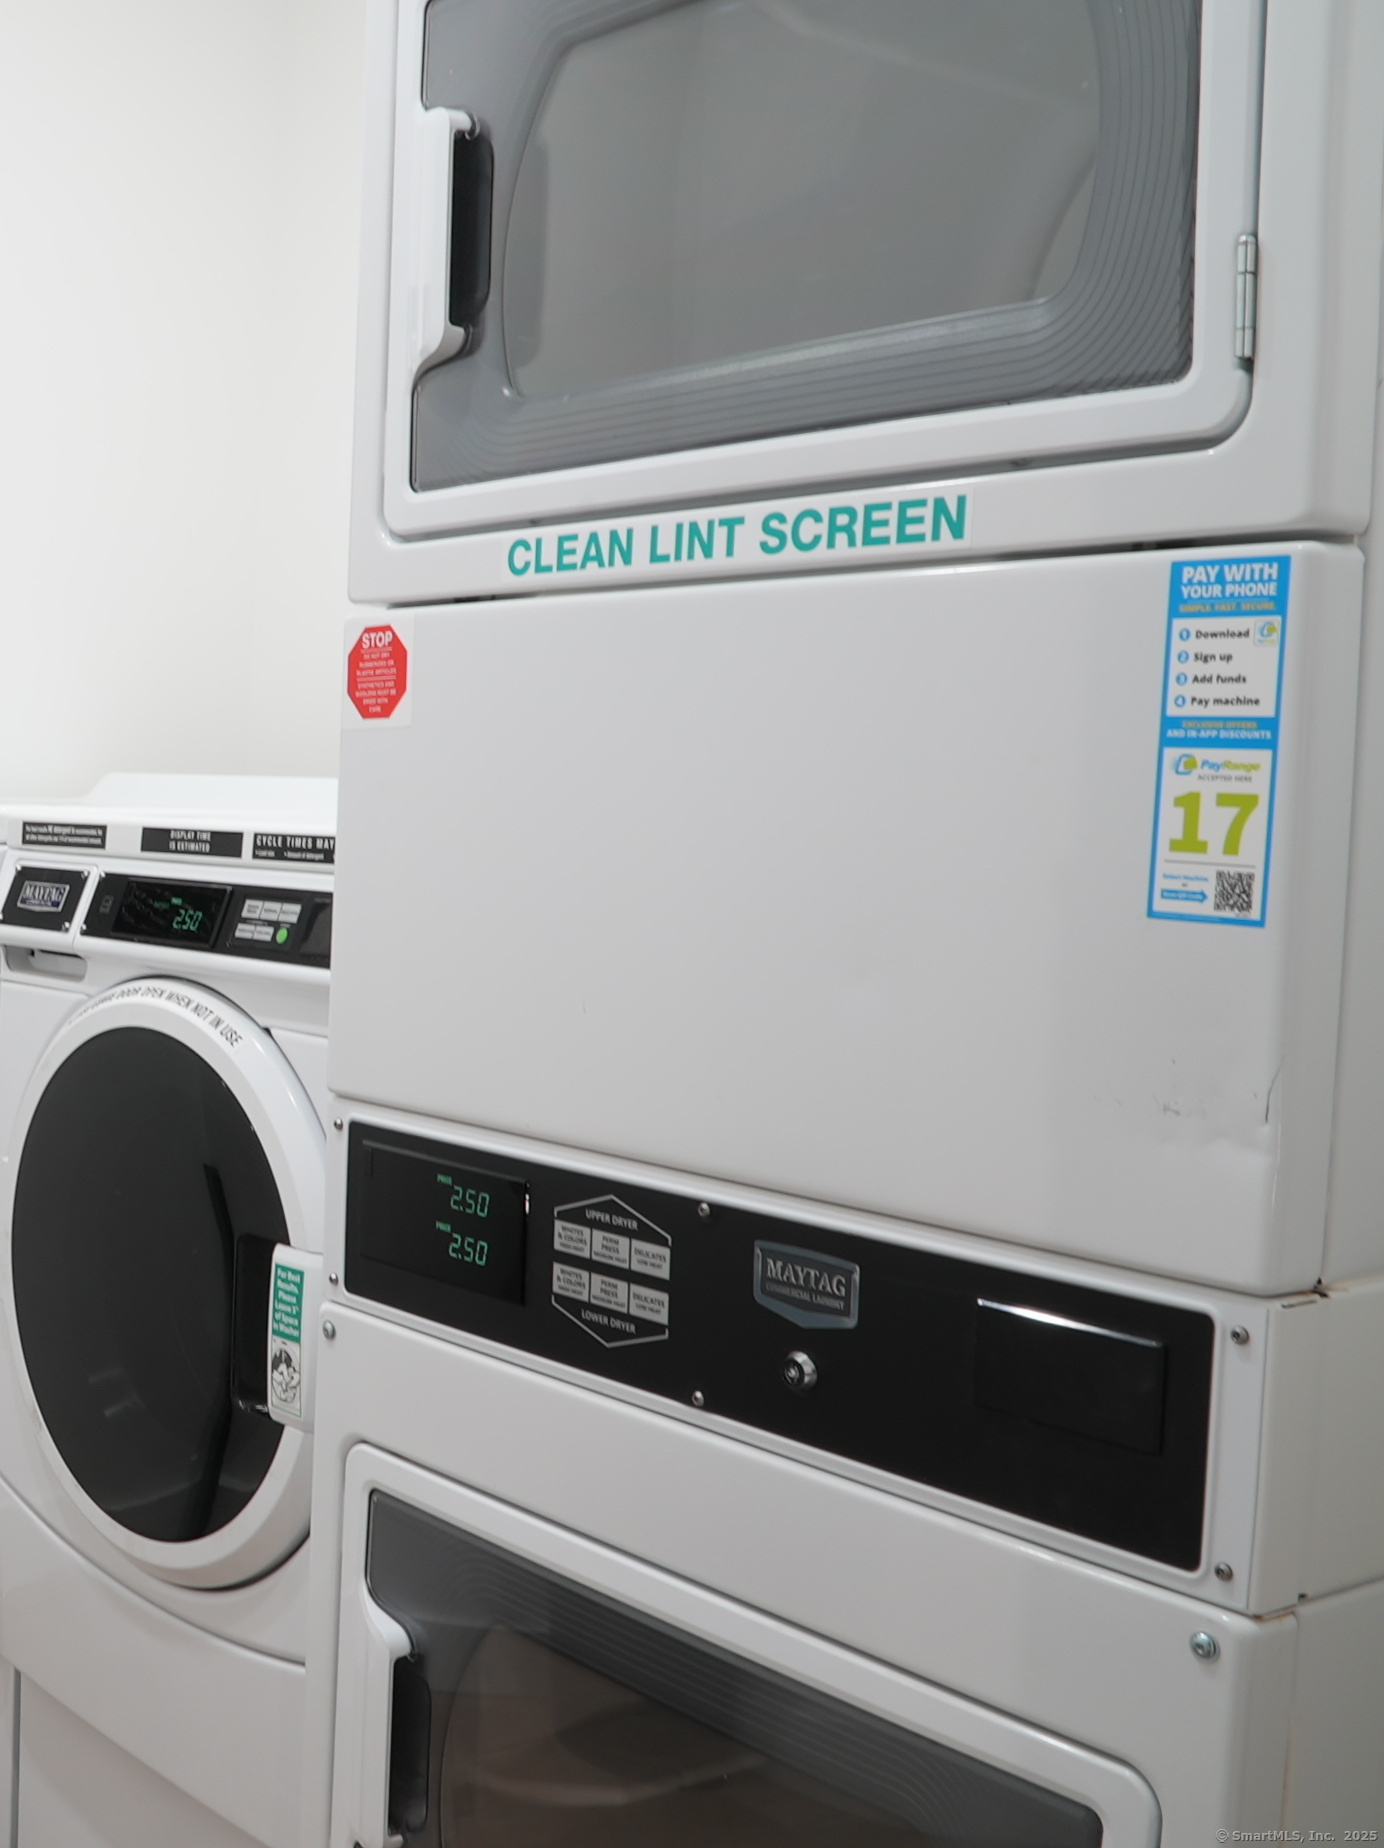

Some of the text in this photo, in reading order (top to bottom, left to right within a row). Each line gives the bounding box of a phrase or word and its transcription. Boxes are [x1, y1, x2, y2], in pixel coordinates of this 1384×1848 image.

[507, 495, 967, 576] CLEAN LINT SCREEN
[1182, 562, 1278, 583] PAY WITH
[1181, 582, 1277, 599] YOUR PHONE
[362, 630, 393, 649] STOP
[1196, 628, 1250, 639] Download
[1193, 652, 1233, 664] Sign up
[1192, 674, 1247, 684] Add funds
[1190, 696, 1260, 708] Pay machine
[1200, 759, 1260, 772] PayRange
[1169, 791, 1260, 856] 17
[196, 831, 212, 841] TIME
[256, 834, 335, 850] CYCLE TIMES MAY
[450, 1184, 490, 1218] 2.50
[585, 1208, 638, 1231] UPPER DRYER
[449, 1232, 488, 1266] 2.50
[766, 1257, 846, 1297] MAYTAG
[581, 1308, 636, 1334] LOWER DRYER
